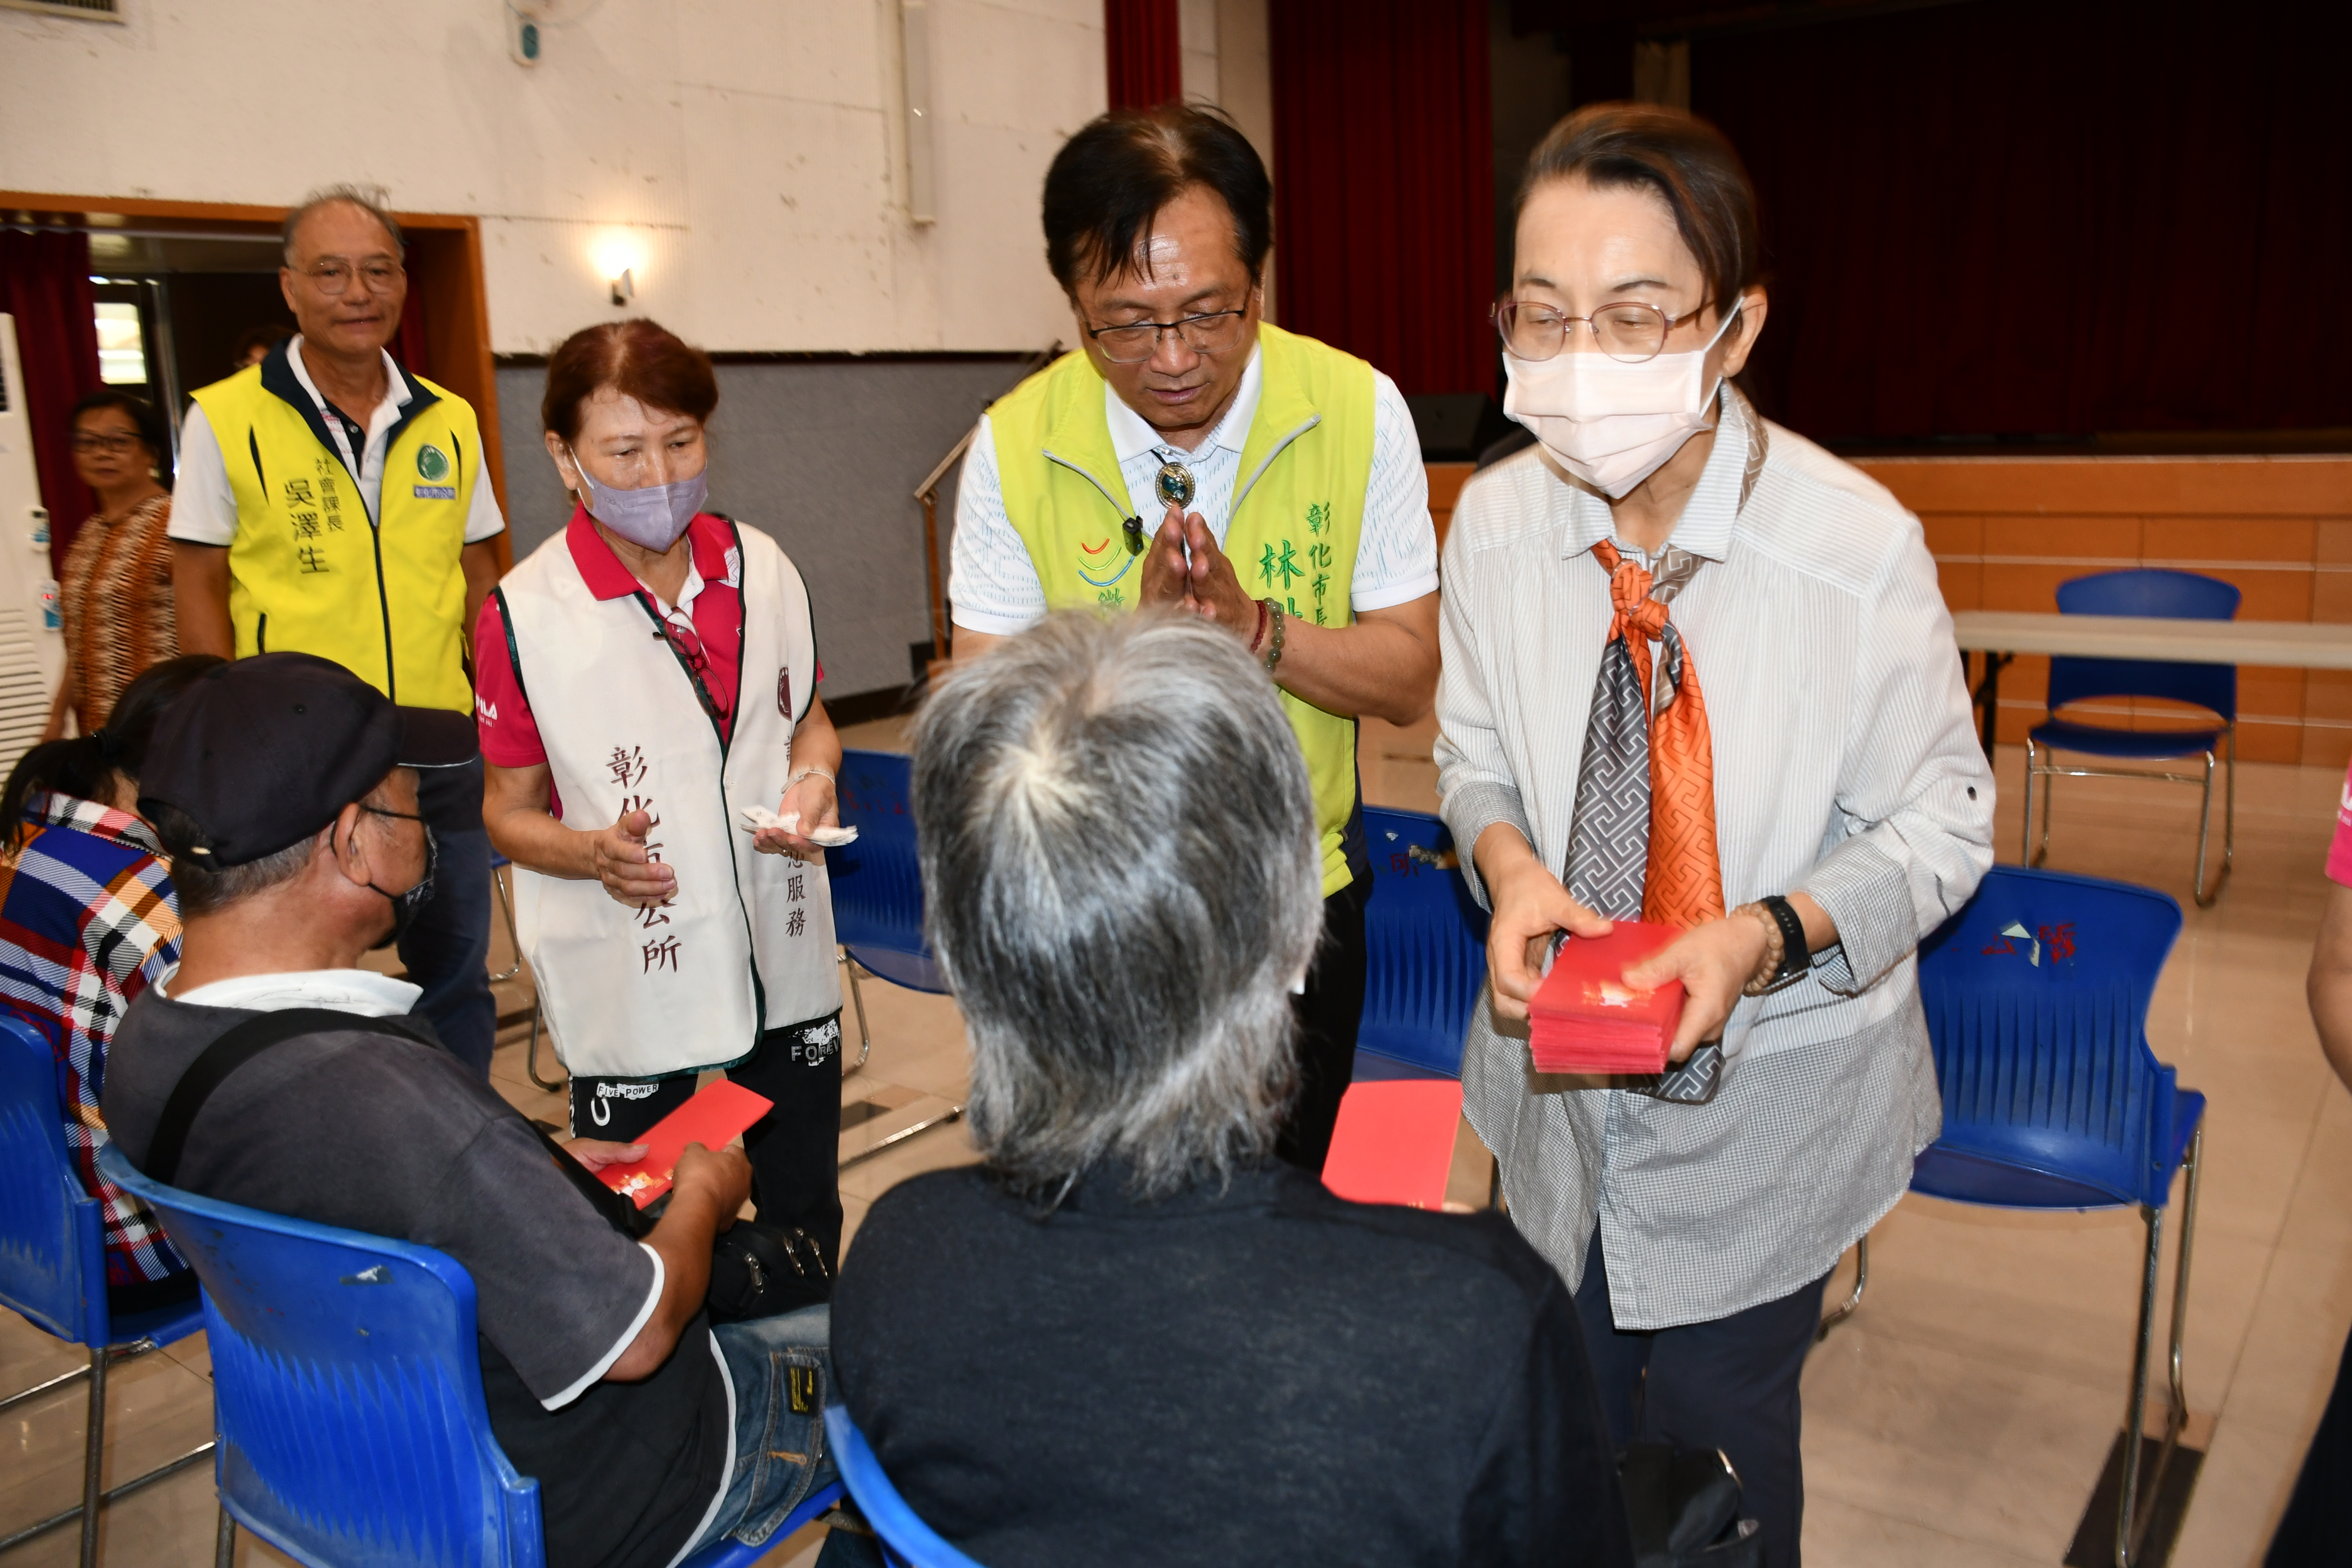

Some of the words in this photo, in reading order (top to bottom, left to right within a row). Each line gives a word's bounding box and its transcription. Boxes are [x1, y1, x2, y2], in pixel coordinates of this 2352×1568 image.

[284, 478, 330, 574] 吳澤生
[315, 458, 345, 532] 社會課長
[598, 1086, 618, 1097] FIVE
[626, 1084, 658, 1097] POWER
